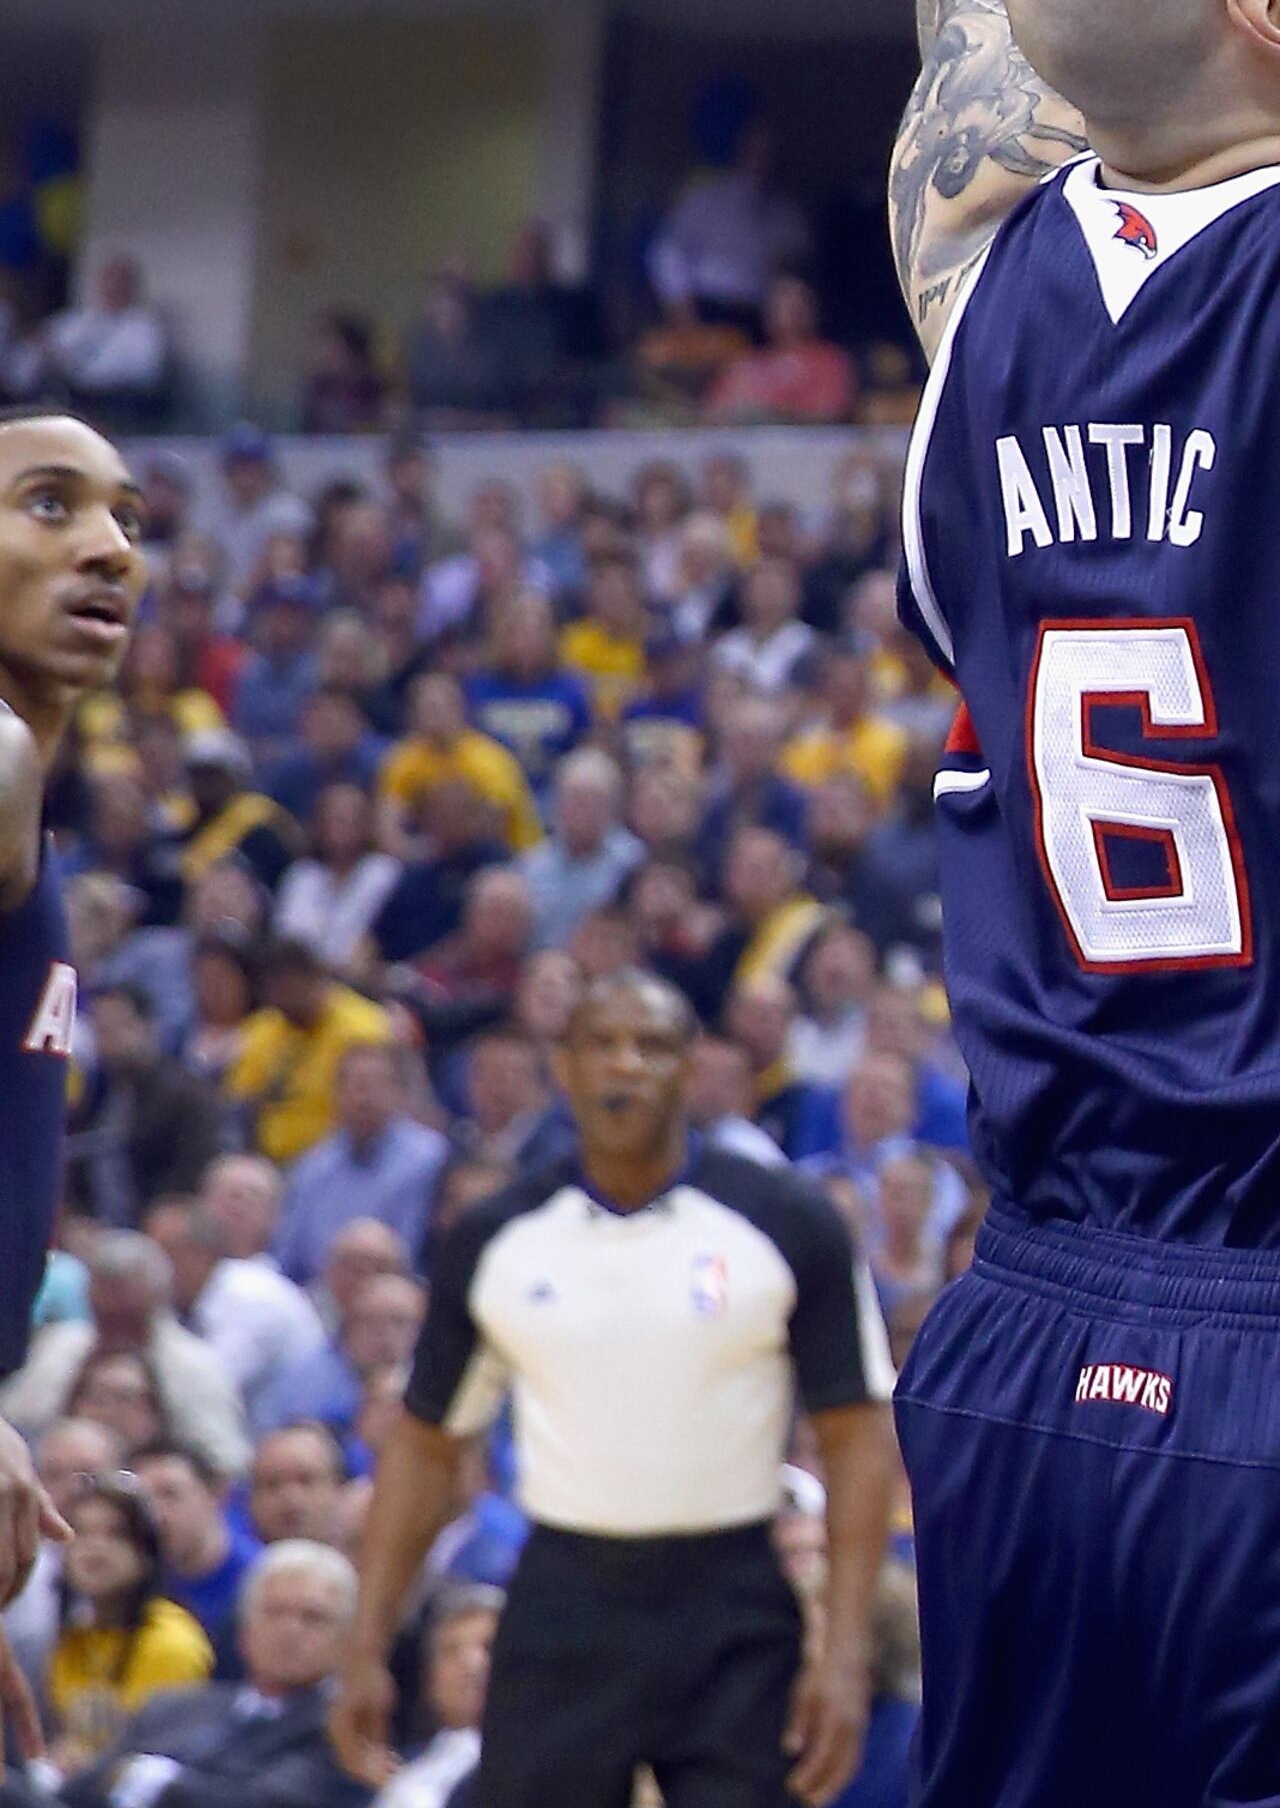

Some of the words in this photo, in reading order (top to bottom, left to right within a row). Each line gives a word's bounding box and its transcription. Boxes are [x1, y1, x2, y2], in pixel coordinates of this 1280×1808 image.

[995, 422, 1217, 558] ANTIC
[1025, 617, 1254, 973] 6
[1075, 1362, 1175, 1416] HAWKS
